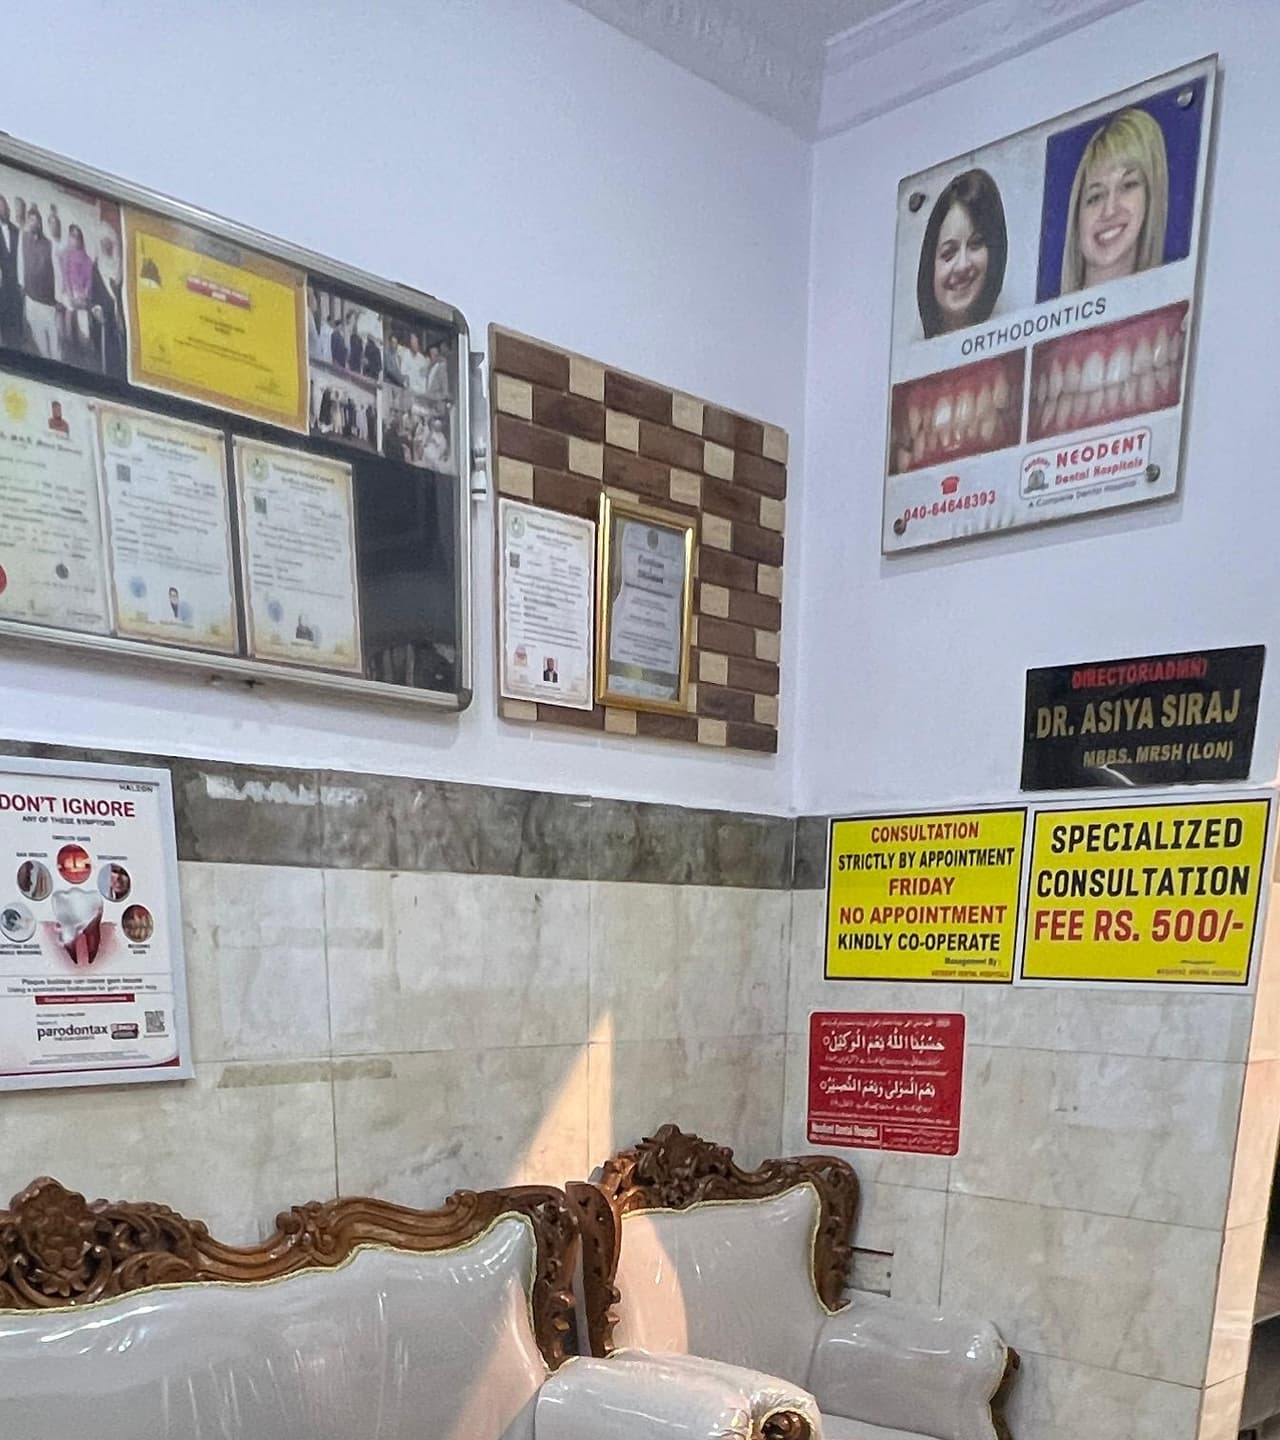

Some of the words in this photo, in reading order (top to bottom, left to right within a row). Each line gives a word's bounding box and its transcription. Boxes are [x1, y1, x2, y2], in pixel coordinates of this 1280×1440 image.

[961, 297, 1107, 356] ORTHODONTICS
[1056, 433, 1147, 468] NEODENT
[1055, 467, 1089, 485] Dental
[1093, 457, 1143, 478] Hospitals
[1037, 705, 1074, 739] DR.
[1080, 697, 1154, 735] ASIYA
[1161, 689, 1241, 728] SIRAJ
[1136, 743, 1183, 764] MRSH
[1187, 741, 1233, 764] (LON)
[63, 798, 136, 817] IGNORE
[871, 822, 979, 843] CONSULTATION
[1051, 817, 1244, 853] SPECIALIZED
[838, 852, 895, 871] STRICTLY
[899, 851, 916, 869] BY
[919, 848, 1015, 868] APPOINTMENT
[889, 877, 955, 896] FRIDAY
[1037, 866, 1250, 897] CONSULTATION
[840, 907, 864, 924] NO
[870, 905, 1007, 924] APPOINTMENT
[1034, 910, 1084, 941] FEE
[1094, 910, 1140, 942] RS.
[1151, 909, 1244, 943] 500/-
[838, 933, 893, 950] KINDLY
[898, 933, 1000, 951] CO-OPERATE
[37, 1024, 108, 1041] parodontax
